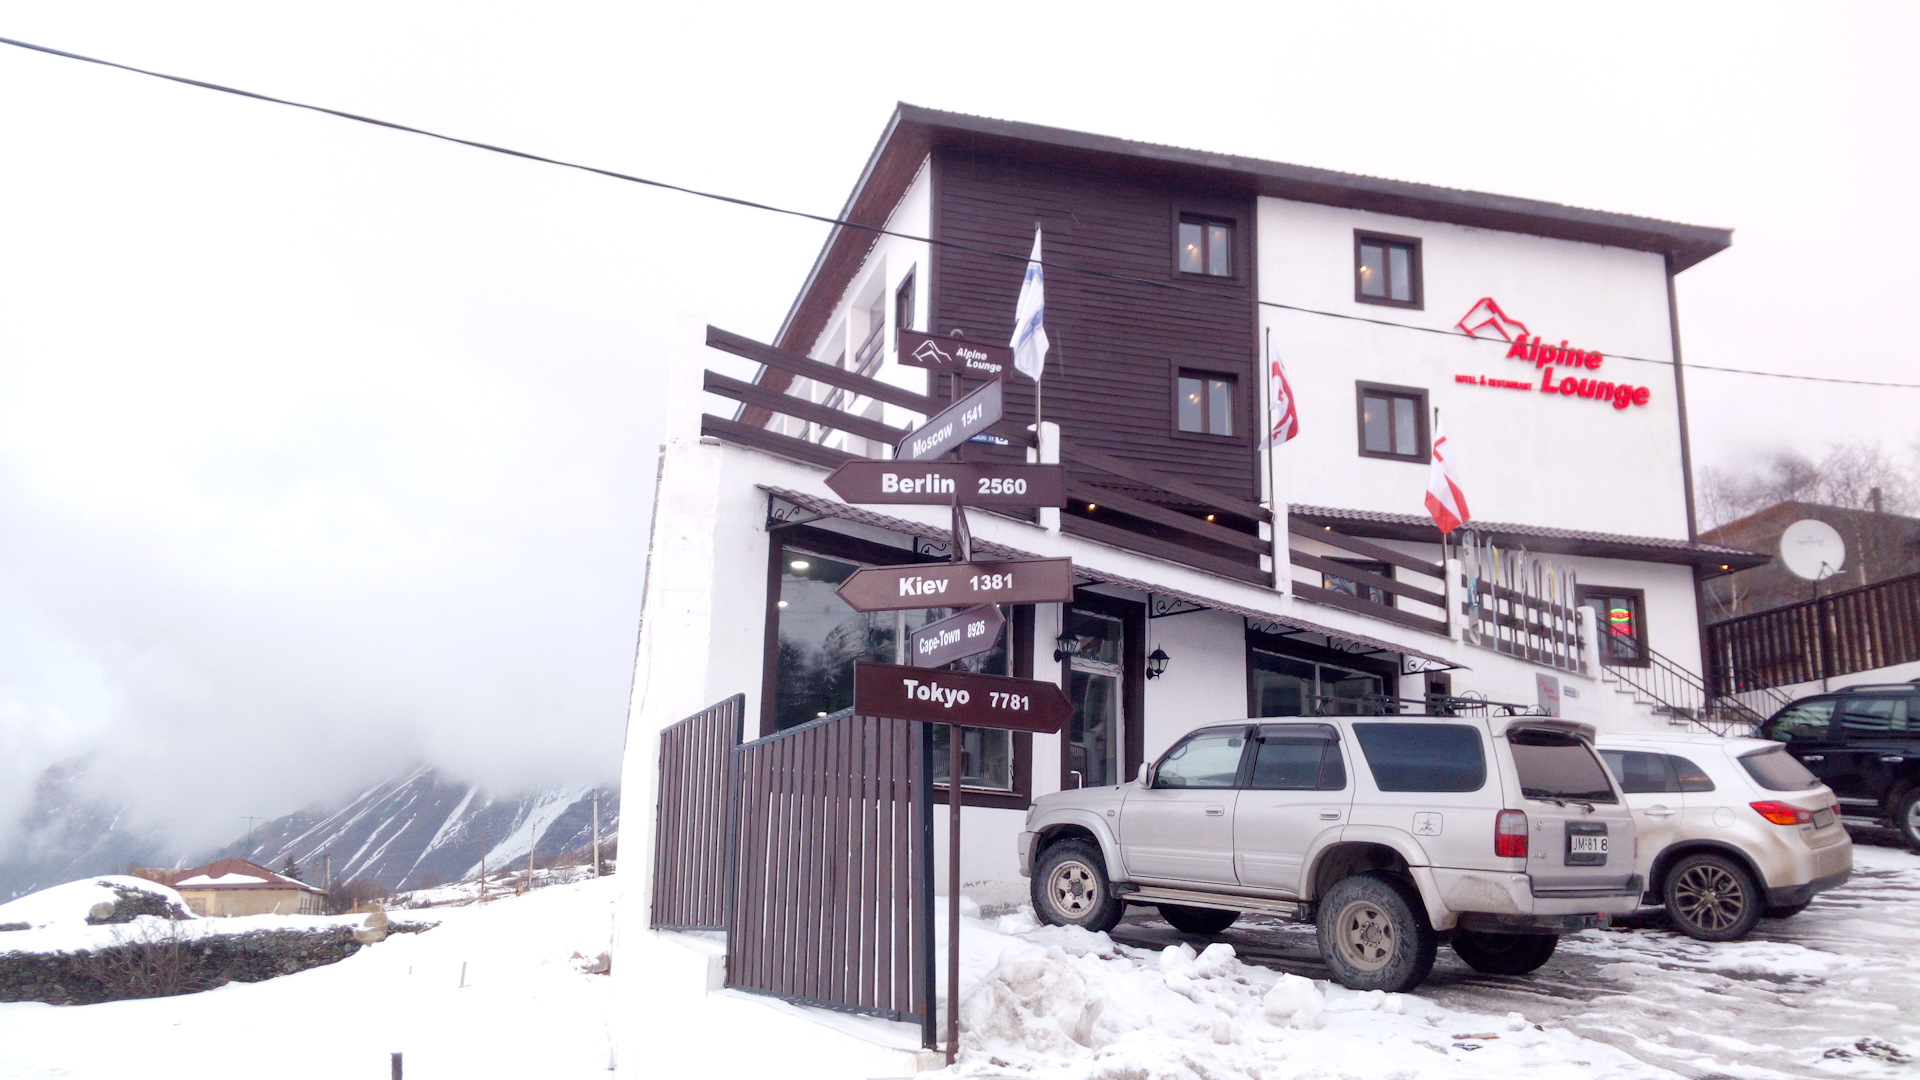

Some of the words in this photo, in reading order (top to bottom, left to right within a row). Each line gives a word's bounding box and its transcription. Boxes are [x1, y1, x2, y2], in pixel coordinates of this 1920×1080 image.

[956, 347, 987, 360] Alpine
[966, 358, 1002, 373] Lounge
[1506, 333, 1604, 370] Alpine
[1540, 366, 1651, 410] Lounge
[912, 422, 953, 458] Moscow
[961, 403, 983, 428] 1541
[881, 473, 955, 494] Berlin
[978, 477, 1027, 495] 2560
[899, 576, 949, 596] Kiev
[969, 572, 1013, 591] 1381
[919, 628, 960, 655] Cape-Town
[967, 619, 985, 638] 8926
[903, 678, 970, 708] Tokyo
[989, 691, 1030, 711] 7781
